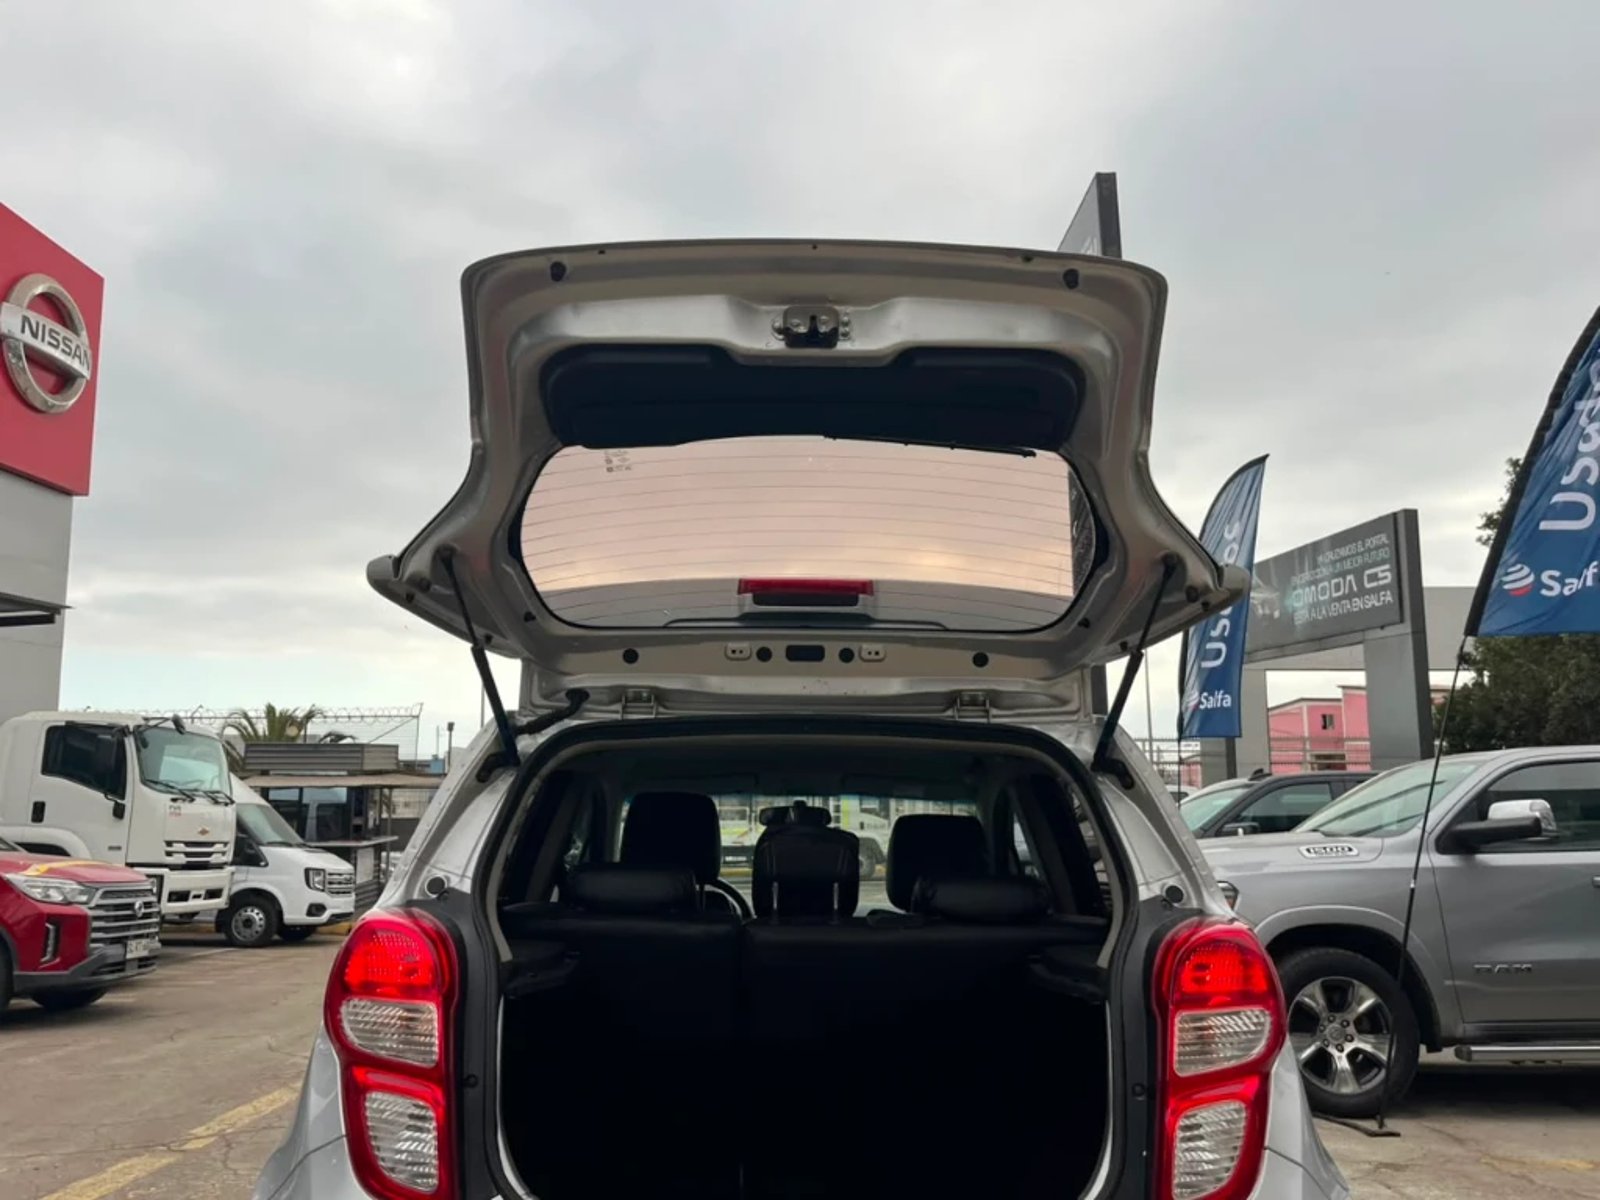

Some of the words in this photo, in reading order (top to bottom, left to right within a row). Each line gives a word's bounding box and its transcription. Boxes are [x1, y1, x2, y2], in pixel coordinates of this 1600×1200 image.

[20, 314, 90, 371] NISSAN
[1292, 574, 1357, 607] OMODA
[1540, 560, 1600, 597] Salf
[1364, 590, 1393, 609] SALFA
[1199, 690, 1232, 709] Salfa
